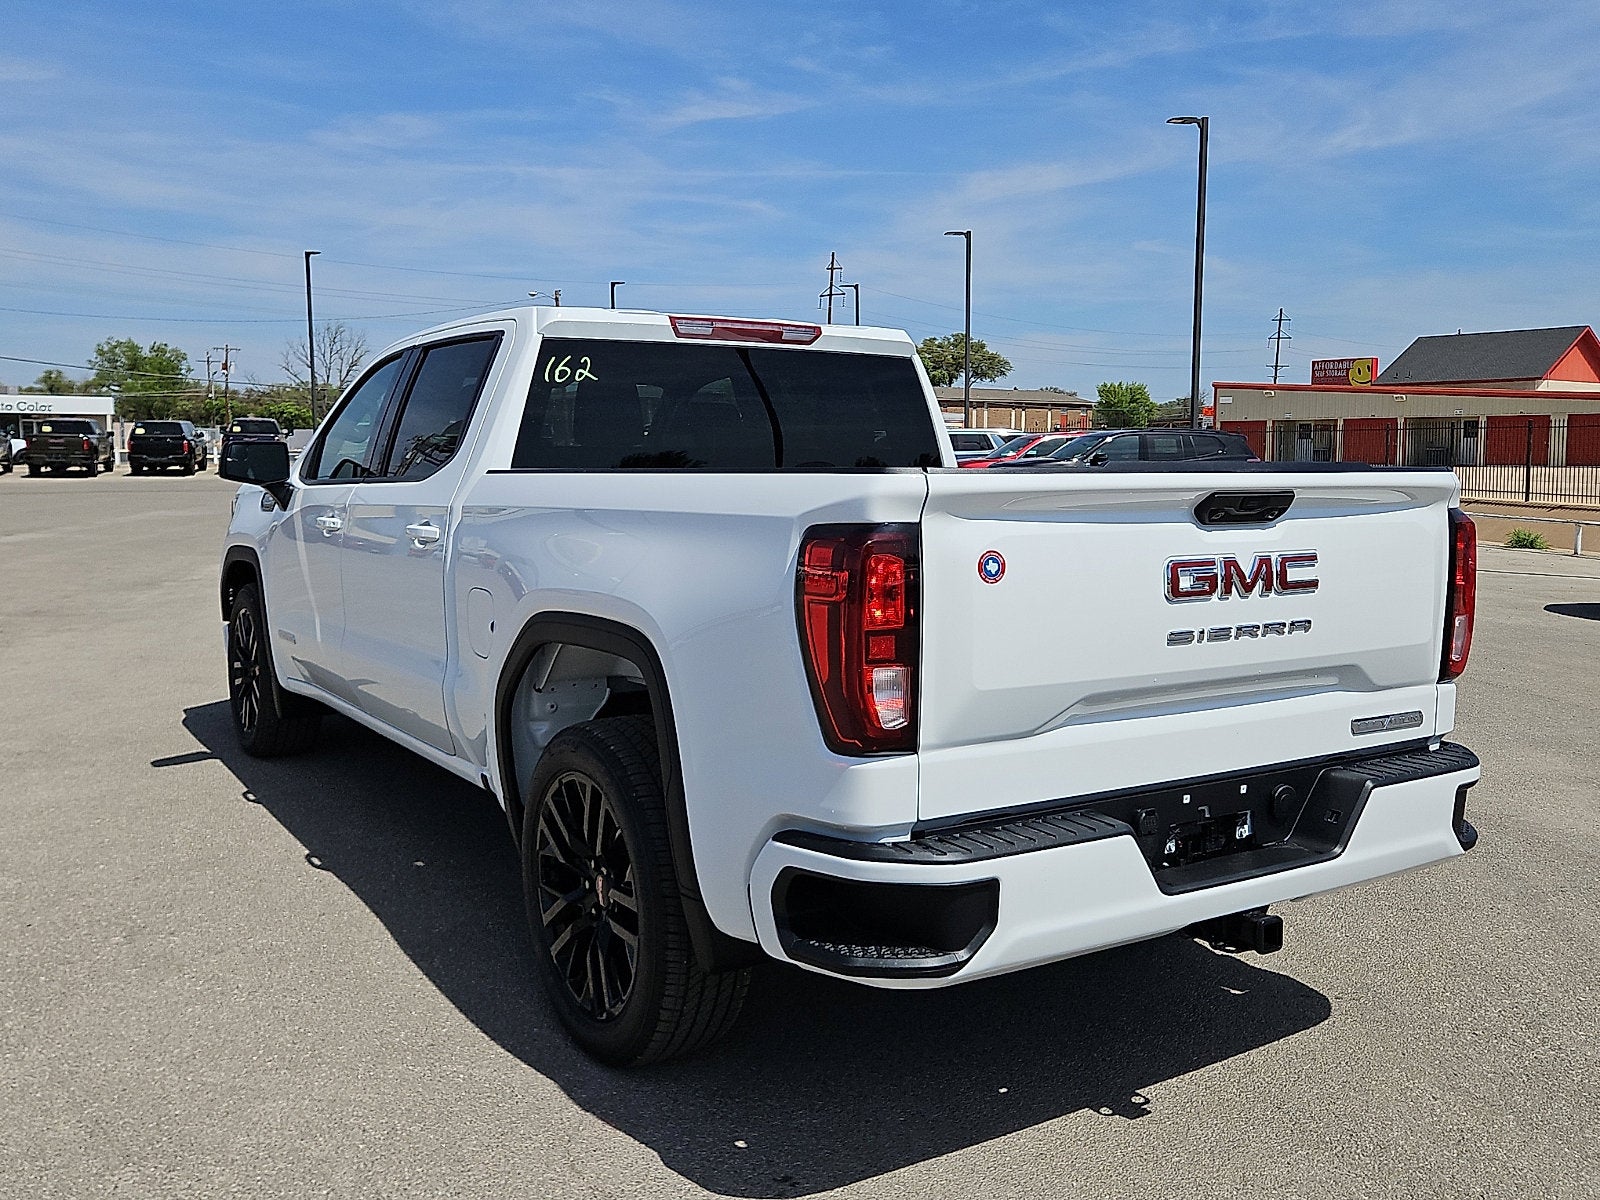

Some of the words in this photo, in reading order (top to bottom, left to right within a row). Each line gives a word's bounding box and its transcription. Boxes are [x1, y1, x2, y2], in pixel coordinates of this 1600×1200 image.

[544, 355, 599, 382] 162
[1313, 361, 1354, 370] AFFORDABLE
[1326, 369, 1347, 377] STORAGE
[16, 401, 52, 411] Color
[1163, 549, 1319, 605] GMC
[1166, 619, 1312, 646] SIERRA
